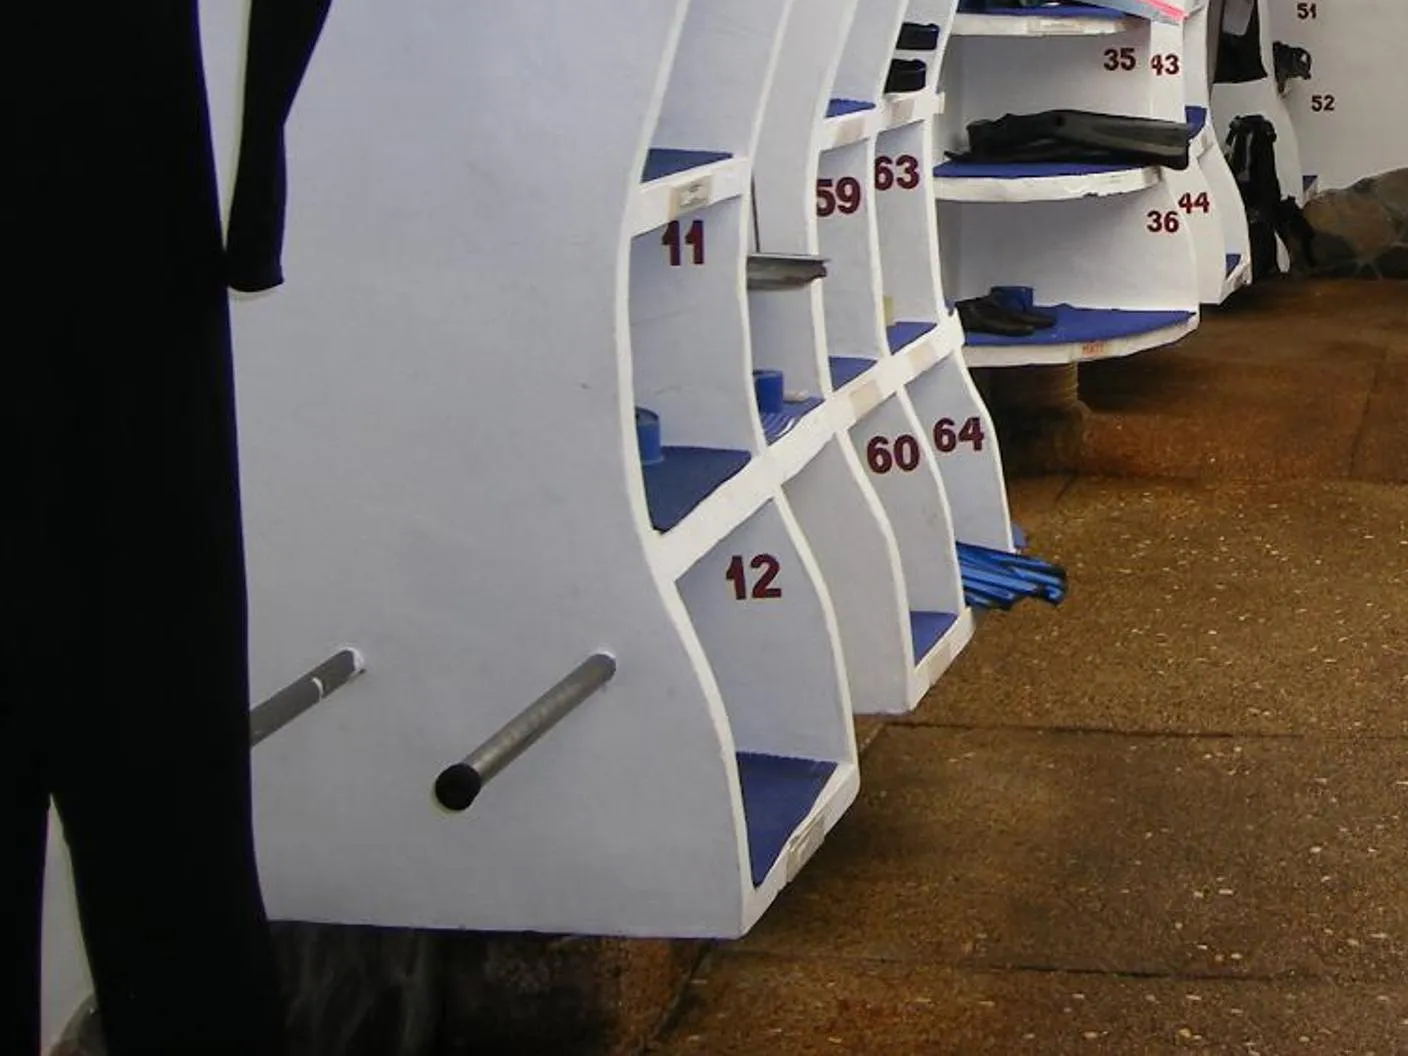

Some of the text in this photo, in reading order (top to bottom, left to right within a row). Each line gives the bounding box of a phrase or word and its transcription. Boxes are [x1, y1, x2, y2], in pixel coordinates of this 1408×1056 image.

[1297, 3, 1316, 19] 51
[1104, 48, 1136, 71] 35
[1151, 54, 1179, 75] 43
[1312, 95, 1335, 112] 52
[875, 155, 919, 191] 63
[816, 177, 861, 217] 59
[1178, 192, 1209, 213] 44
[1147, 210, 1179, 233] 36
[661, 220, 704, 266] 11
[933, 417, 984, 452] 64
[867, 435, 920, 474] 60
[726, 554, 781, 600] 12
